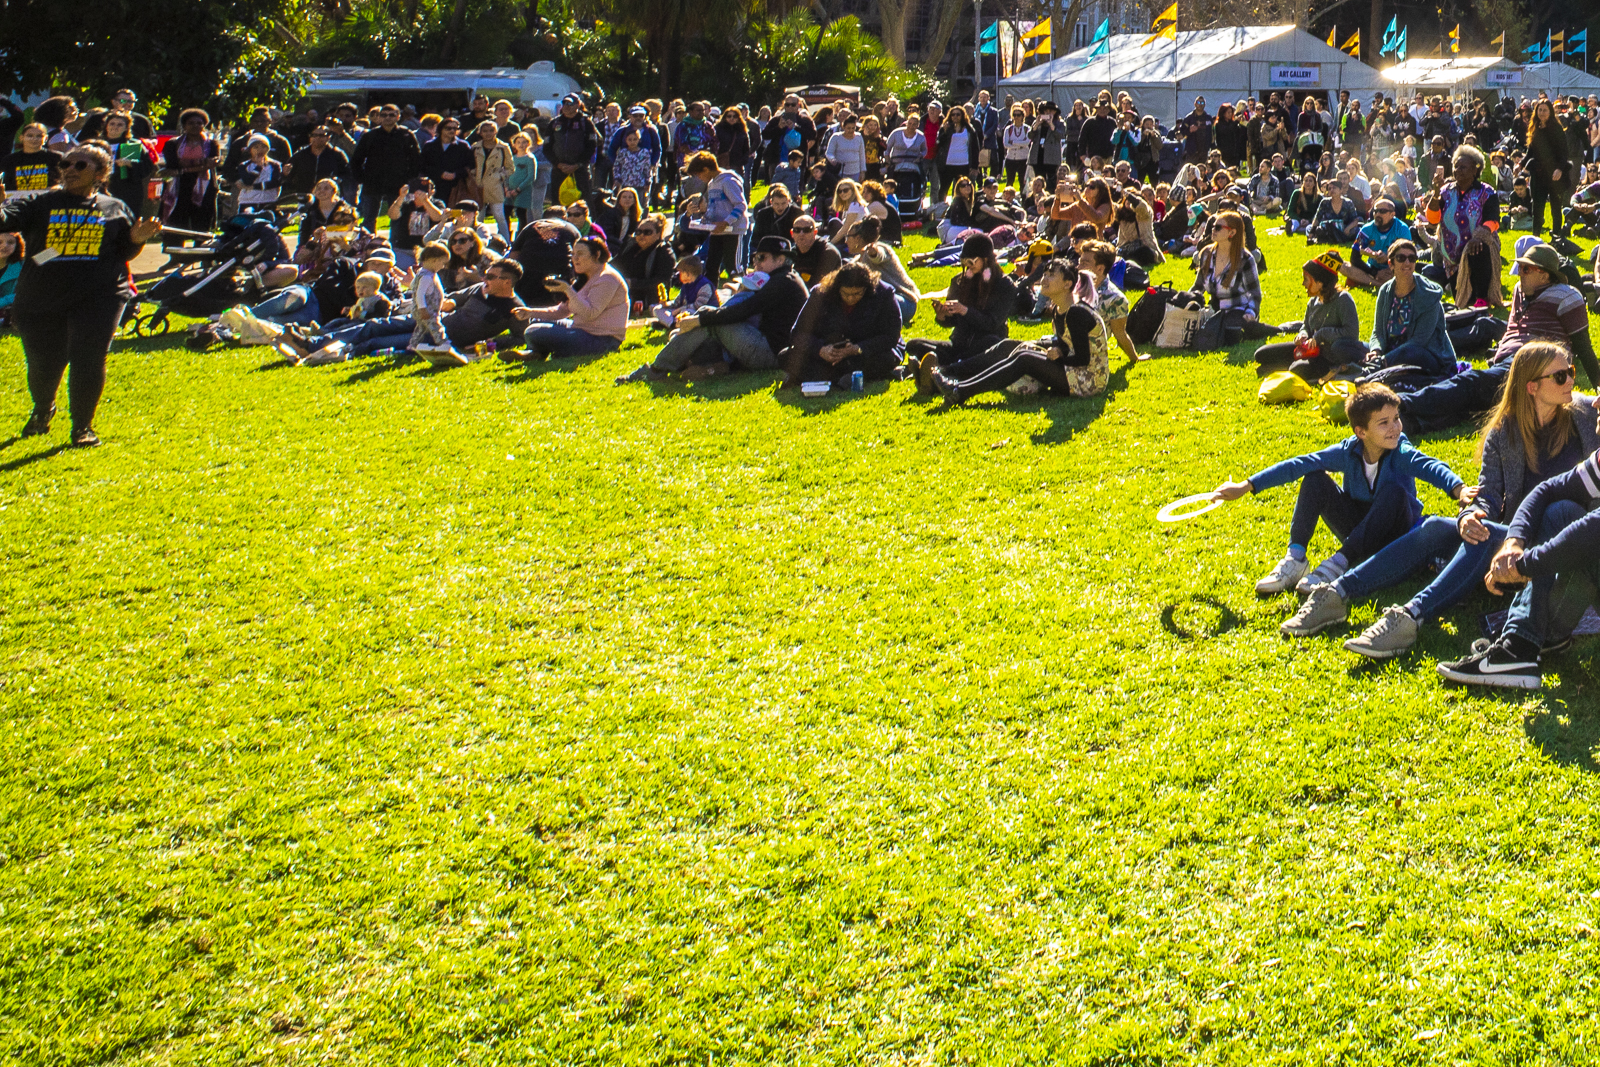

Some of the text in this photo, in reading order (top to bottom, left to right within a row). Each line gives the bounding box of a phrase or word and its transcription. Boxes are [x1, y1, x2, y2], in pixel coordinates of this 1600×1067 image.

[1279, 70, 1312, 78] ART GALLERY
[49, 215, 106, 225] NAIDOC
